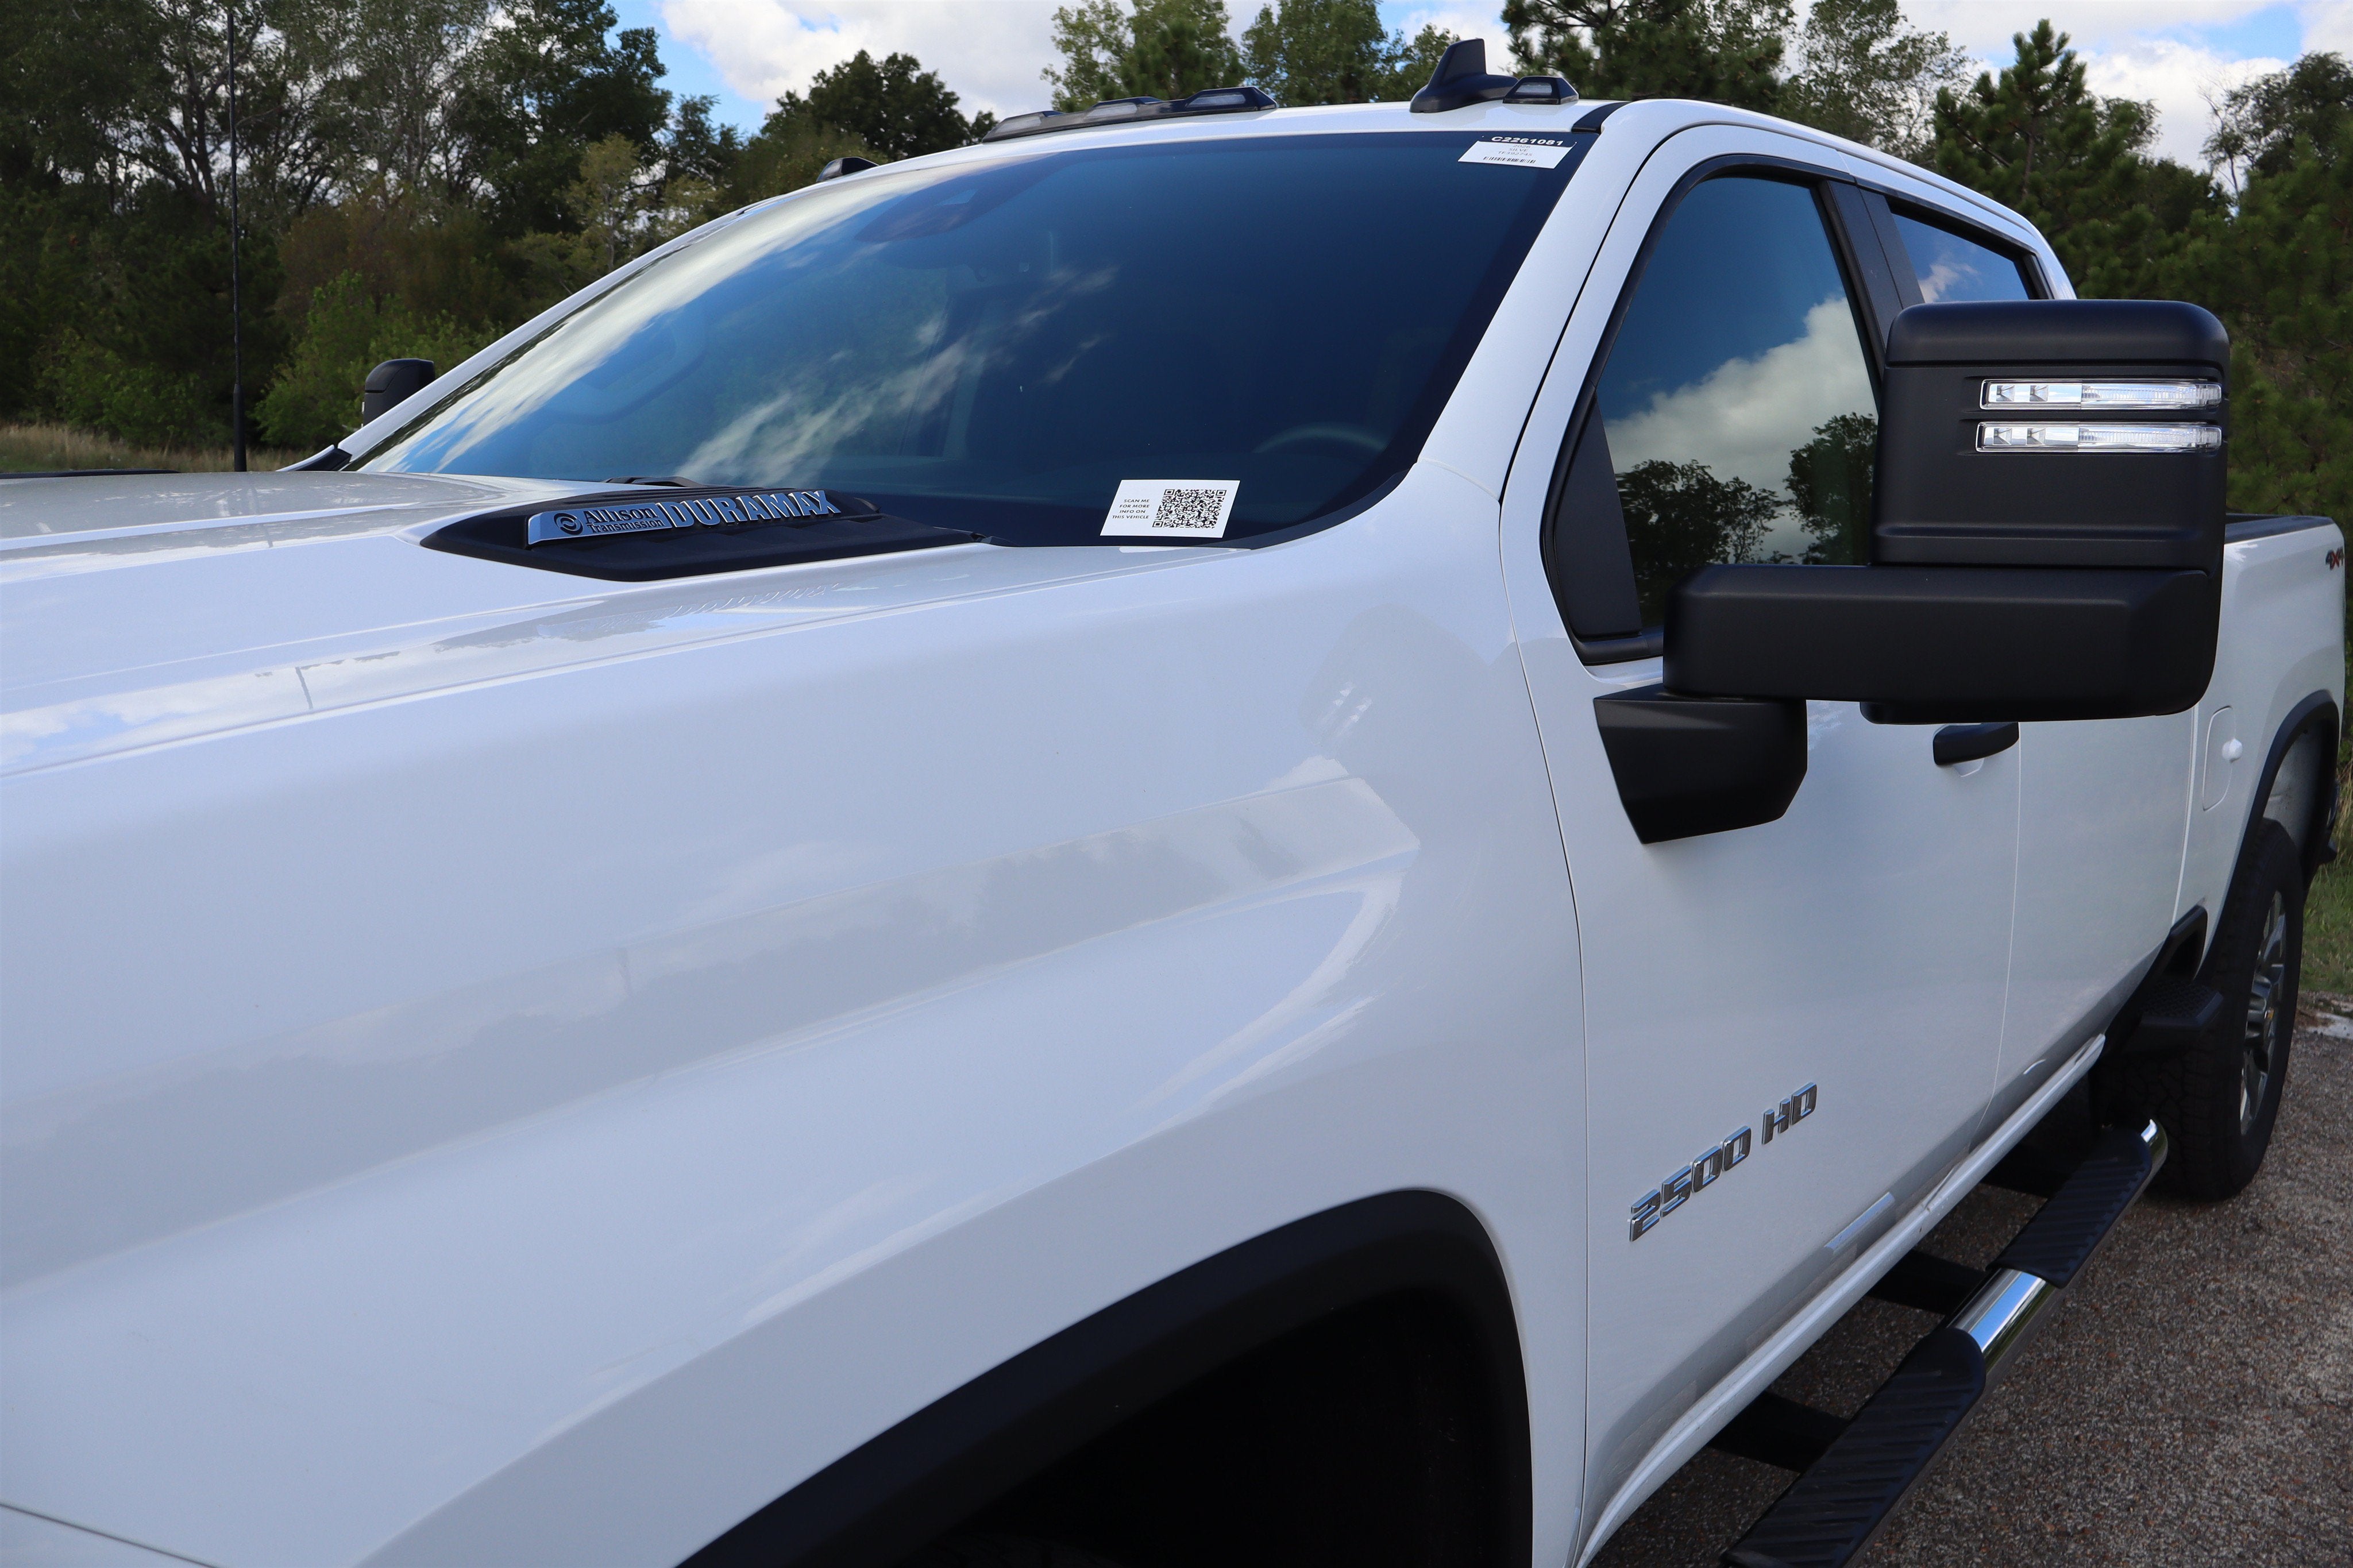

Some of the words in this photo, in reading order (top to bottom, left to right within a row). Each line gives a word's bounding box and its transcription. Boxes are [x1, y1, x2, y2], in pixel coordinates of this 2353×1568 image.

[1491, 136, 1563, 146] C2261081
[583, 508, 659, 524] Allison
[655, 491, 841, 528] DURAMAX
[587, 519, 665, 533] Transmission
[1629, 1125, 1752, 1242] 2500
[1761, 1082, 1818, 1145] HD
